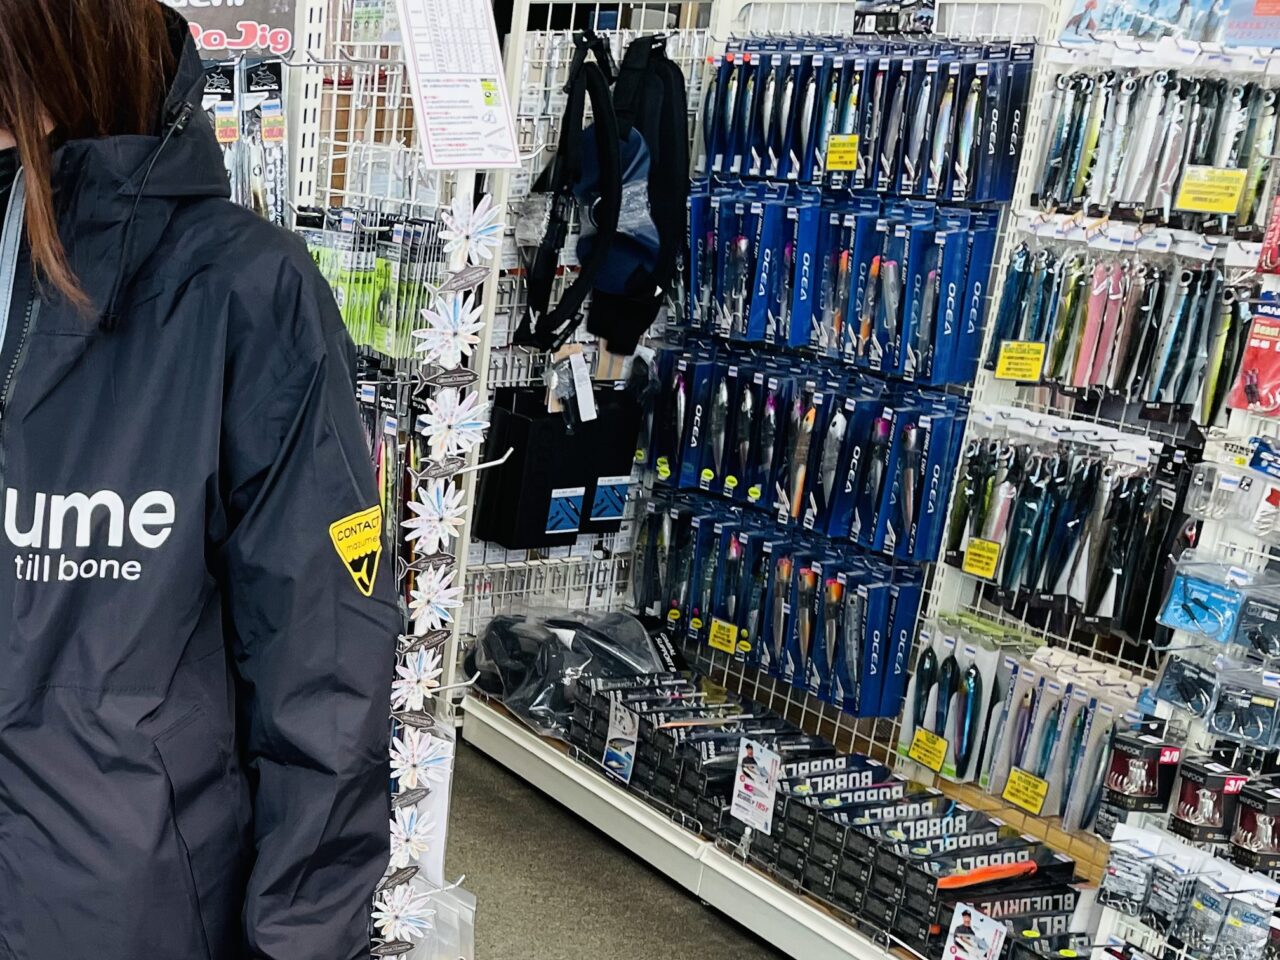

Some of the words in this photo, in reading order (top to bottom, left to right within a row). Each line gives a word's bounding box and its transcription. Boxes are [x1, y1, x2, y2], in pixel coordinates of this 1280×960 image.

[988, 108, 999, 155] OCEA
[1009, 109, 1021, 156] OCEA
[758, 248, 771, 296] OCEA
[800, 252, 810, 300] OCEA
[943, 282, 956, 336] OCEA
[967, 281, 982, 334] OCEA
[690, 404, 703, 448] OCEA
[844, 445, 861, 493] OCEA
[927, 464, 941, 514] OCEA
[4, 488, 176, 549] ume
[15, 555, 50, 583] till
[58, 552, 142, 581] bone
[870, 630, 880, 675] OCEA
[894, 629, 908, 675] OCEA
